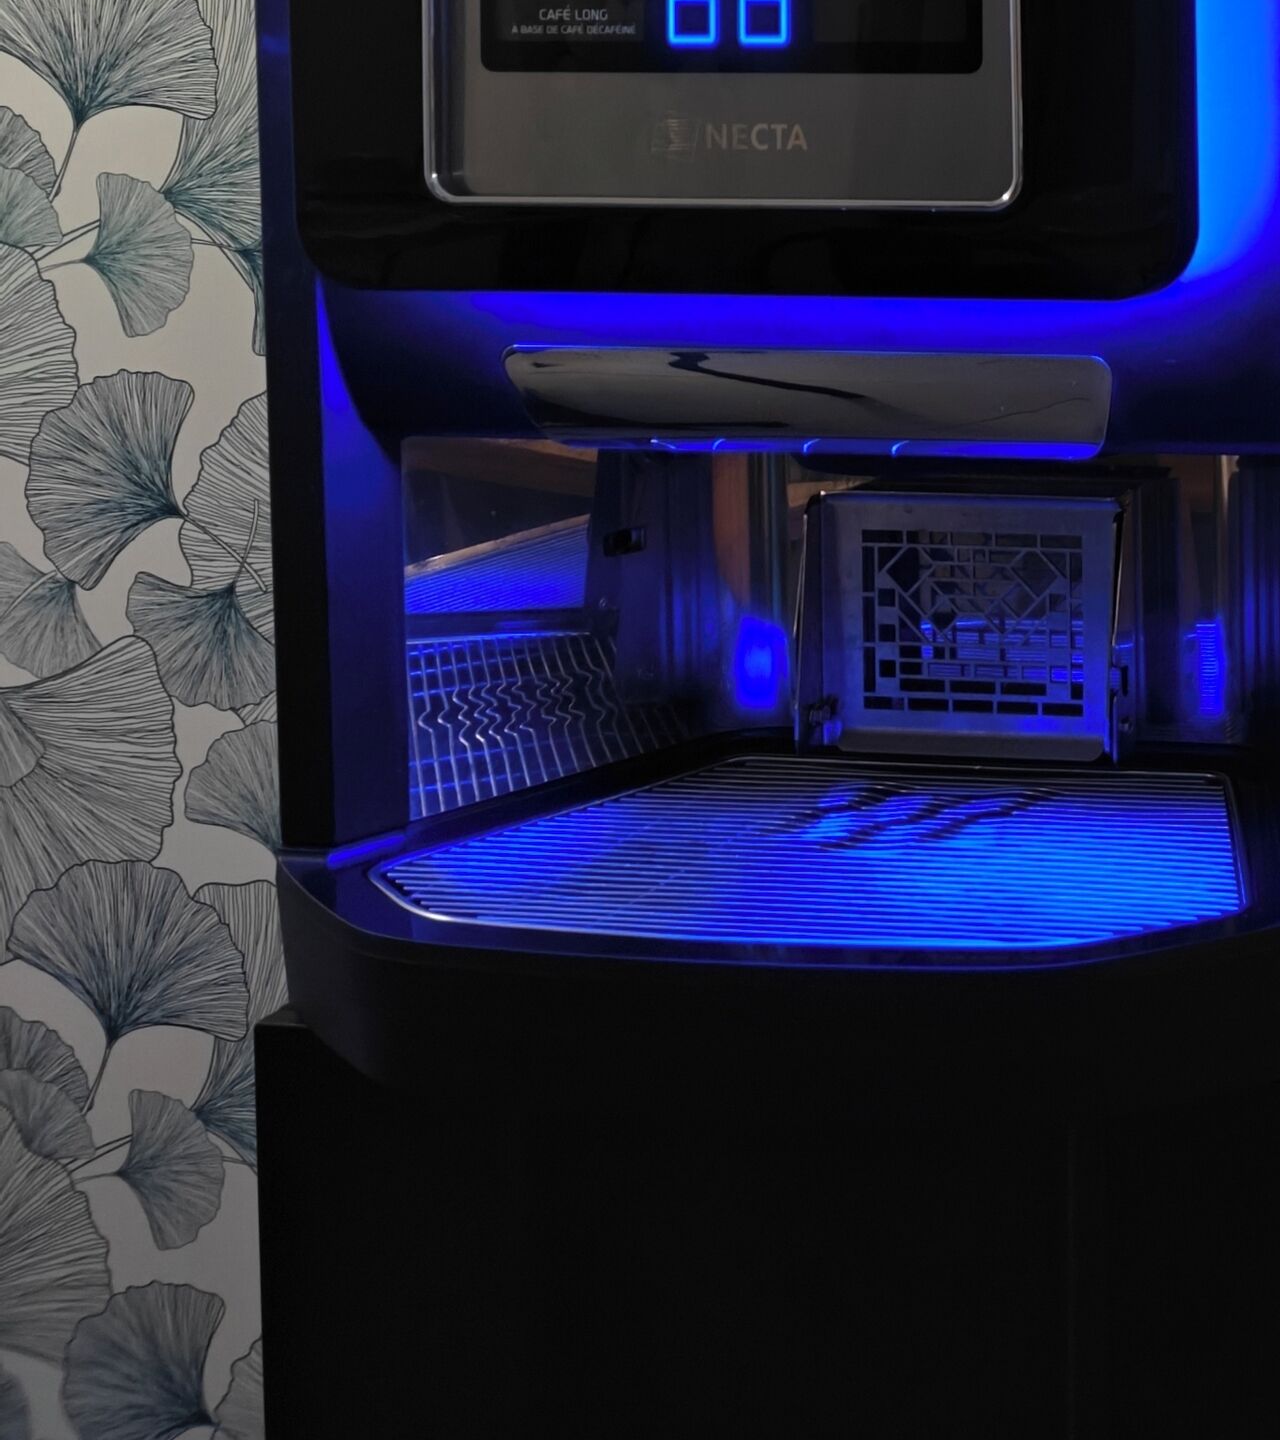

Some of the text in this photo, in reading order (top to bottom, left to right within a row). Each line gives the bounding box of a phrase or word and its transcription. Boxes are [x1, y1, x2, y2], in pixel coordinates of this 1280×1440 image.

[538, 4, 609, 21] CAFÉ LONG
[520, 25, 544, 35] BASE
[546, 25, 559, 35] DE
[560, 23, 584, 35] CAFÉ
[705, 123, 808, 152] NECTA
